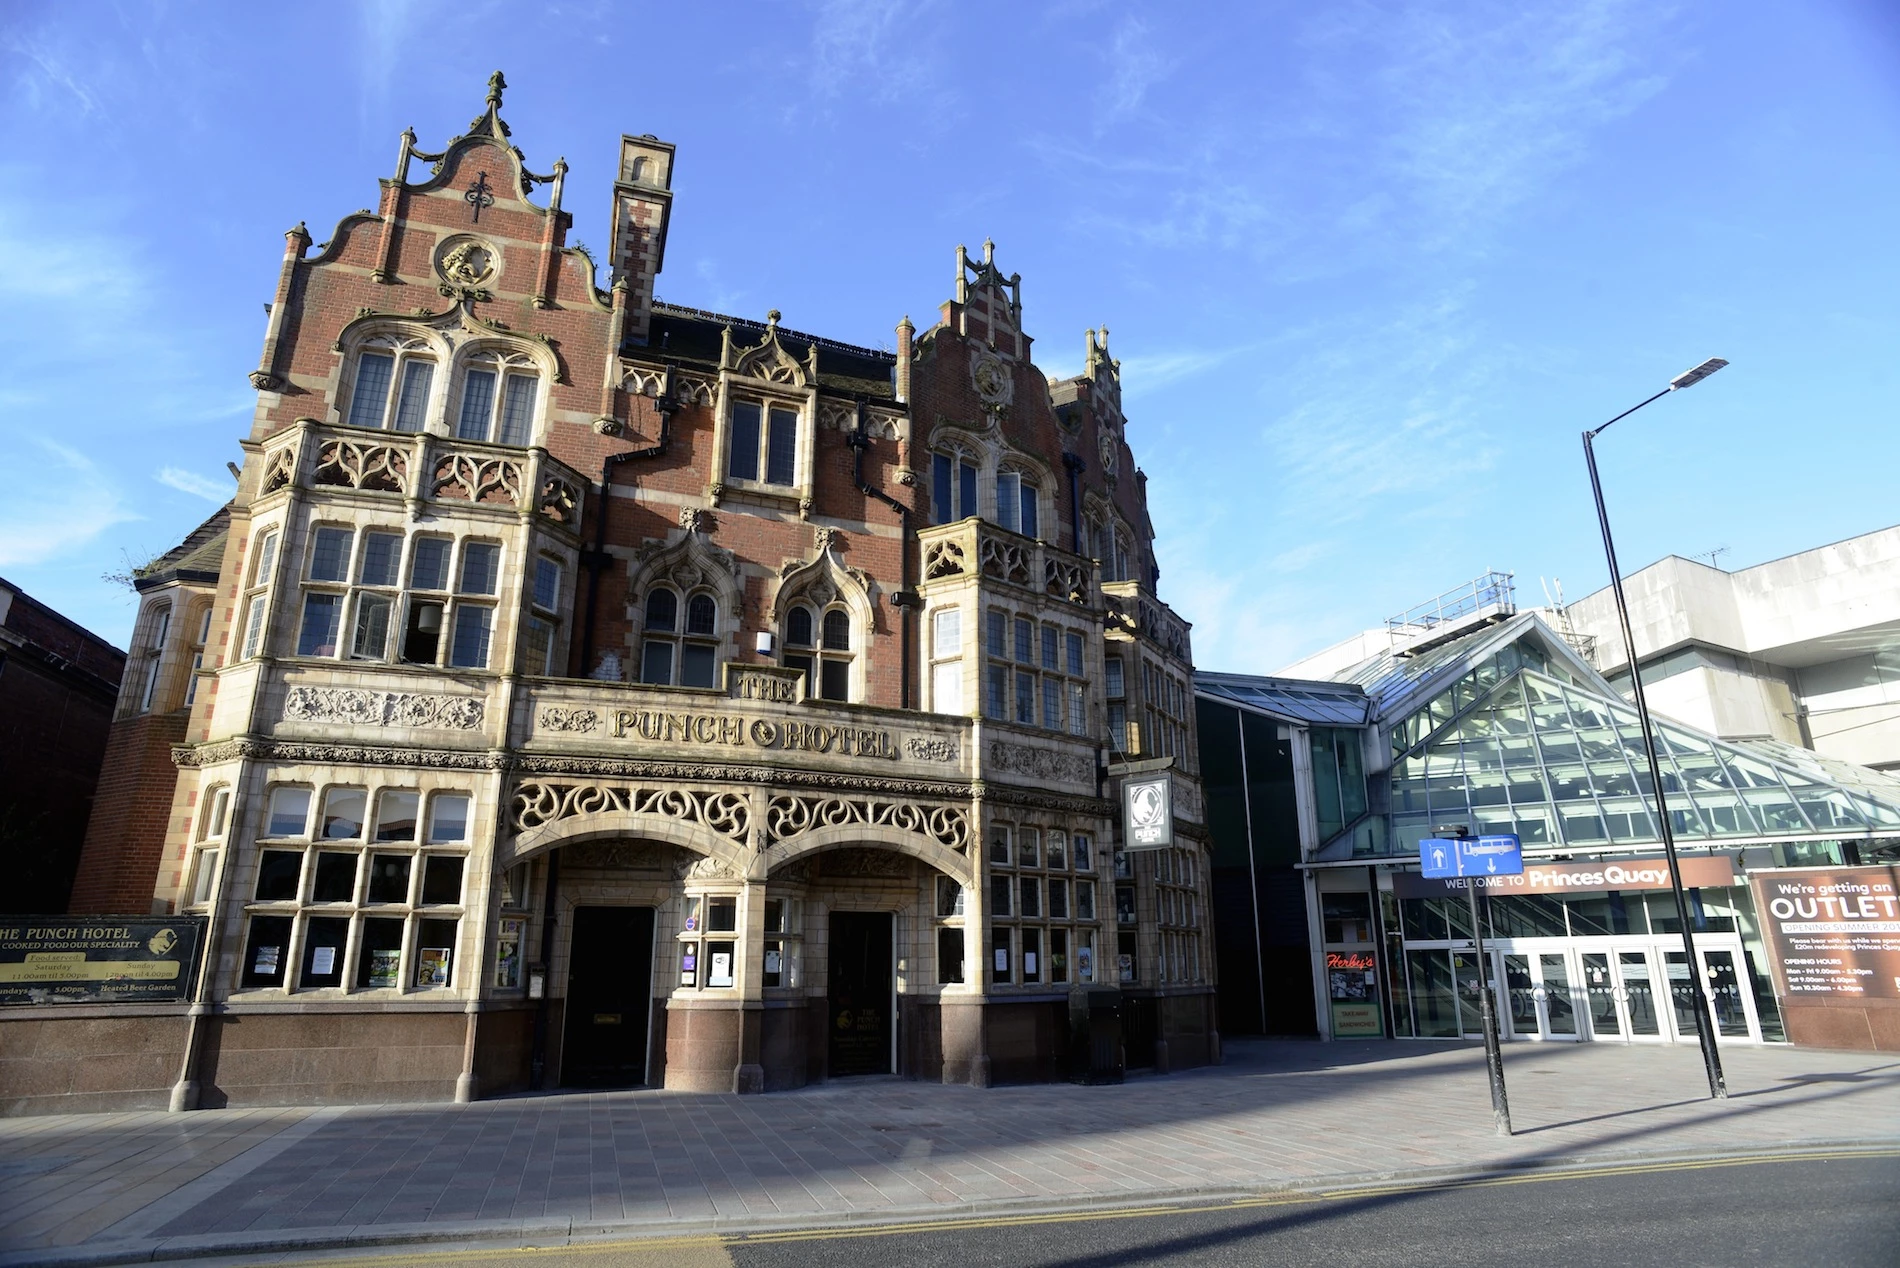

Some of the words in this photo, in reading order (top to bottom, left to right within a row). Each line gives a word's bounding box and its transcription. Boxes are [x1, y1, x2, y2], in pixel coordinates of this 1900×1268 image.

[738, 675, 796, 701] THE
[610, 709, 745, 746] PUNCH
[781, 720, 897, 760] HOTEL
[1445, 877, 1504, 889] WELOME
[1507, 875, 1525, 886] TO
[1778, 883, 1815, 894] We're
[1818, 882, 1870, 896] getting
[1873, 884, 1892, 892] an
[1770, 896, 1900, 919] OUTLET
[26, 928, 78, 940] PUNCH
[82, 928, 131, 940] HOTEL
[1784, 924, 1831, 932] OPENING
[1833, 923, 1880, 931] SUMMER
[2, 942, 41, 950] COOKED
[43, 941, 69, 949] FOOD
[90, 941, 140, 949] SPECIALITY
[1327, 954, 1374, 970] Herby's
[129, 984, 147, 992] Beer
